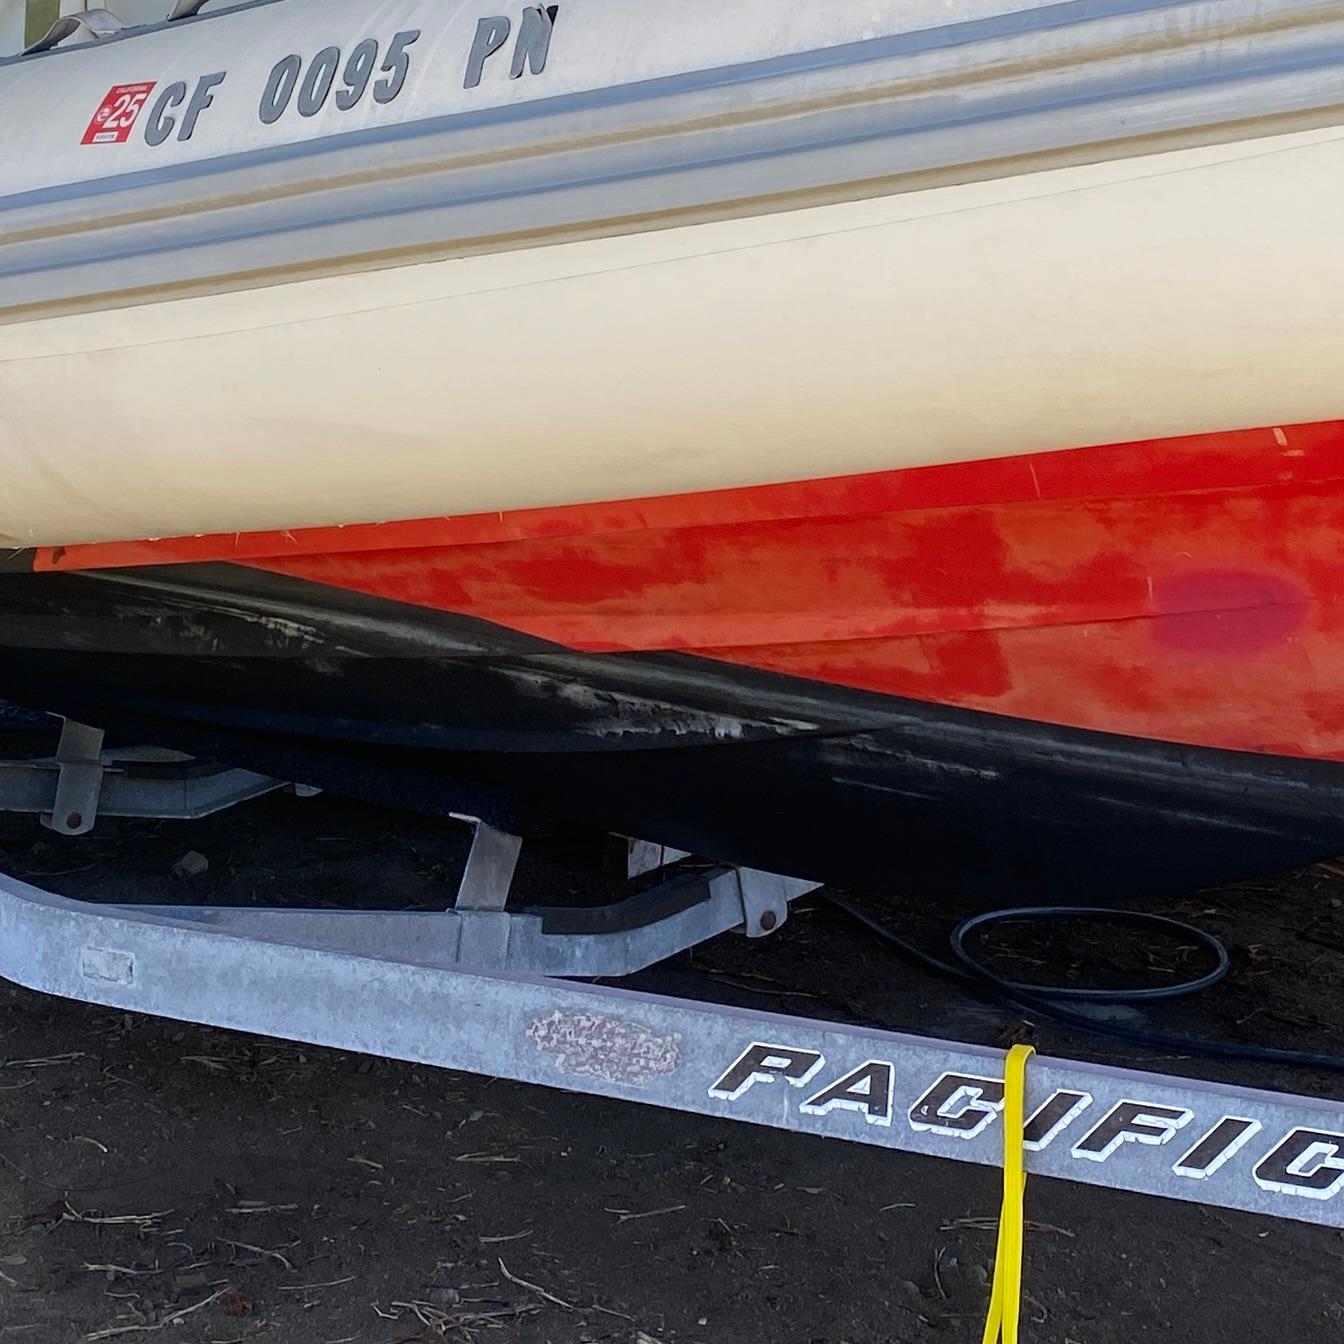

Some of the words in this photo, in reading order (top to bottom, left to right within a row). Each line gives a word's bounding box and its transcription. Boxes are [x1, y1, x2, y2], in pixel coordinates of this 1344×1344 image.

[102, 93, 148, 129] 25
[144, 71, 227, 147] CF
[259, 29, 421, 124] 0095
[463, 3, 559, 89] PN
